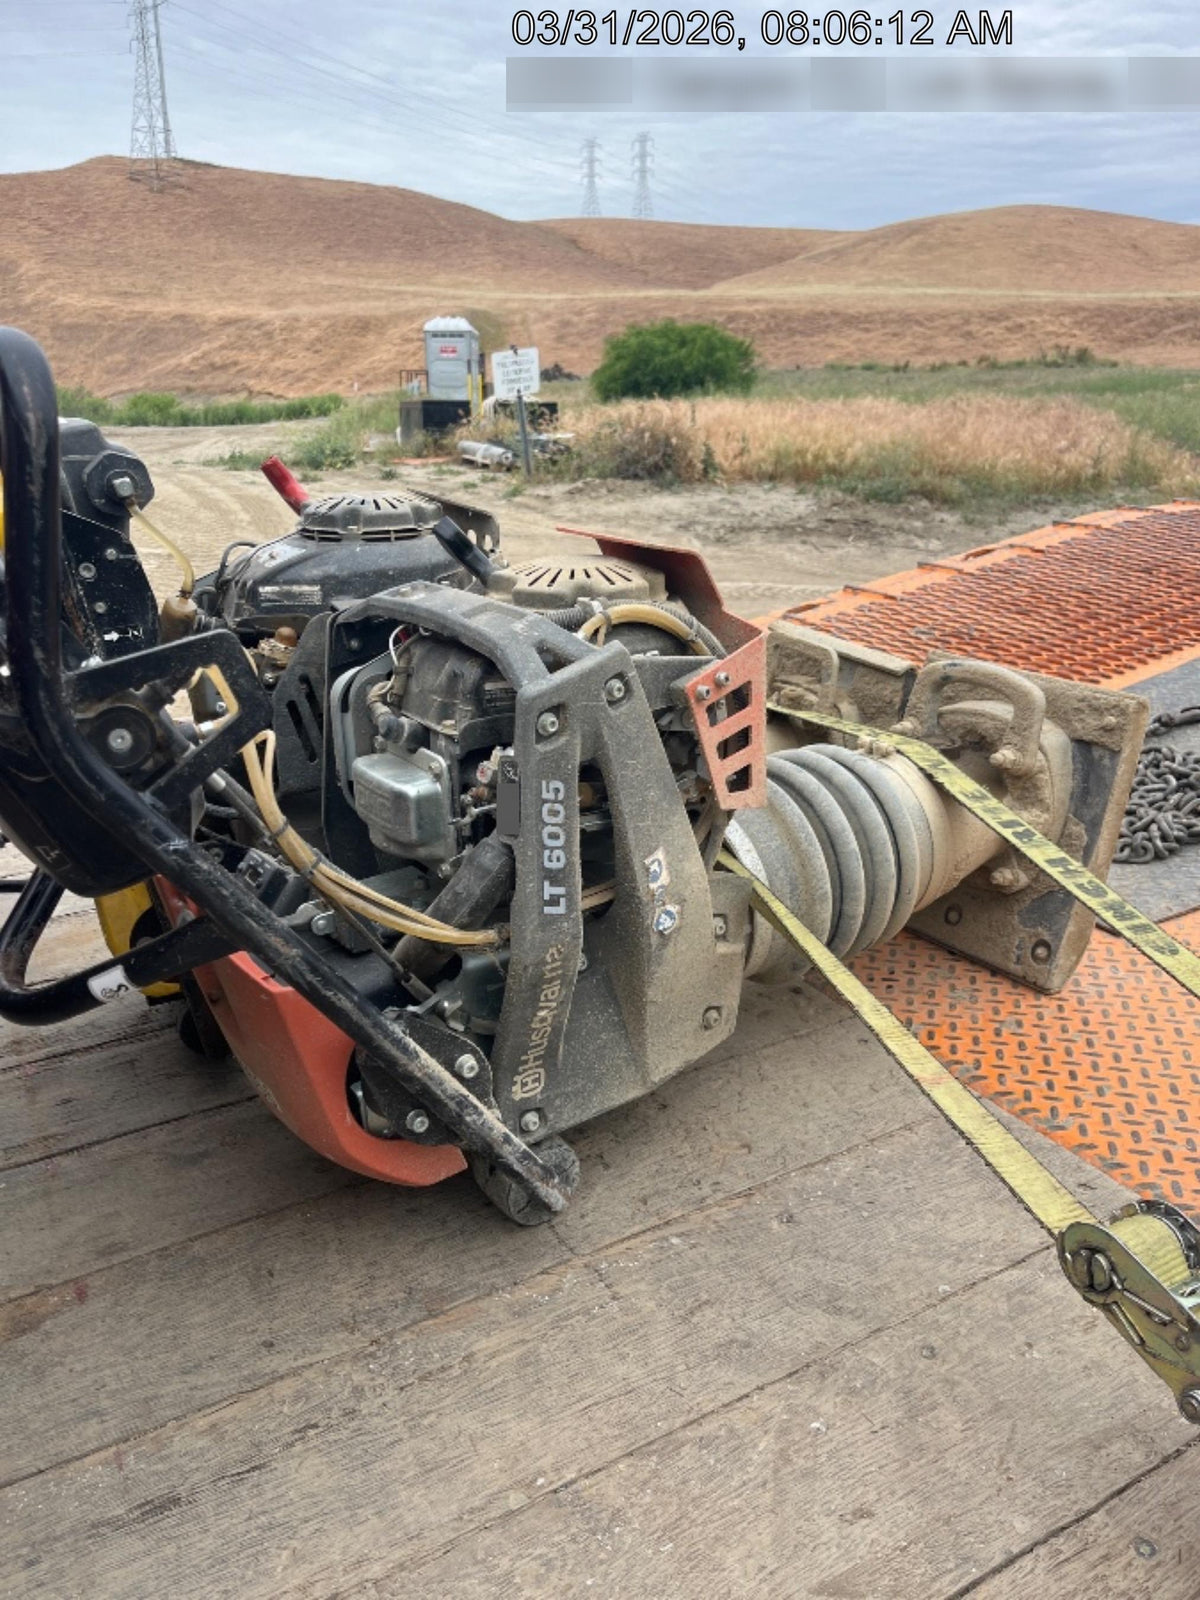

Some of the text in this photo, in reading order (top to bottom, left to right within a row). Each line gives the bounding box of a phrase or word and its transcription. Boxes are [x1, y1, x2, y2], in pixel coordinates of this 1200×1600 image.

[541, 779, 566, 915] LT 6005
[519, 943, 565, 1073] Husqvarna
